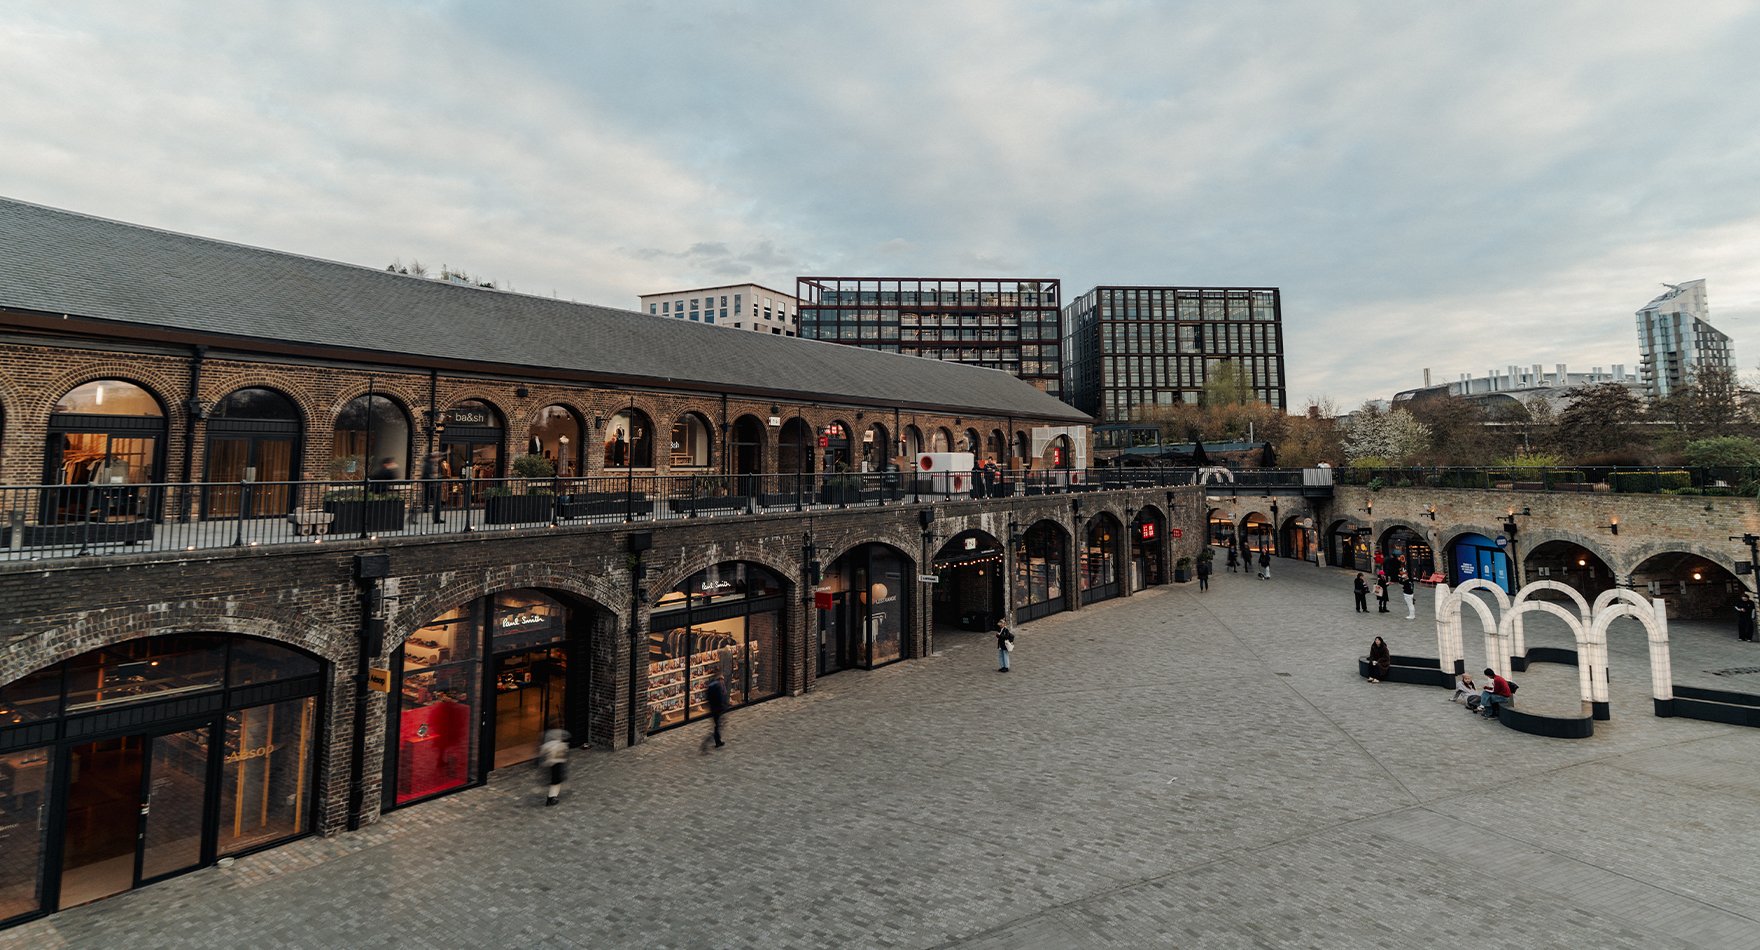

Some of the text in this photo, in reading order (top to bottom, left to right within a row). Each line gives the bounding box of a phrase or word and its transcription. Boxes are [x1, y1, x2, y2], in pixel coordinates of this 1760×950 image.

[455, 413, 484, 422] ba&sh
[702, 580, 731, 591] Paul Smith
[502, 615, 545, 628] Paul Smith
[228, 745, 274, 762] Aesop
